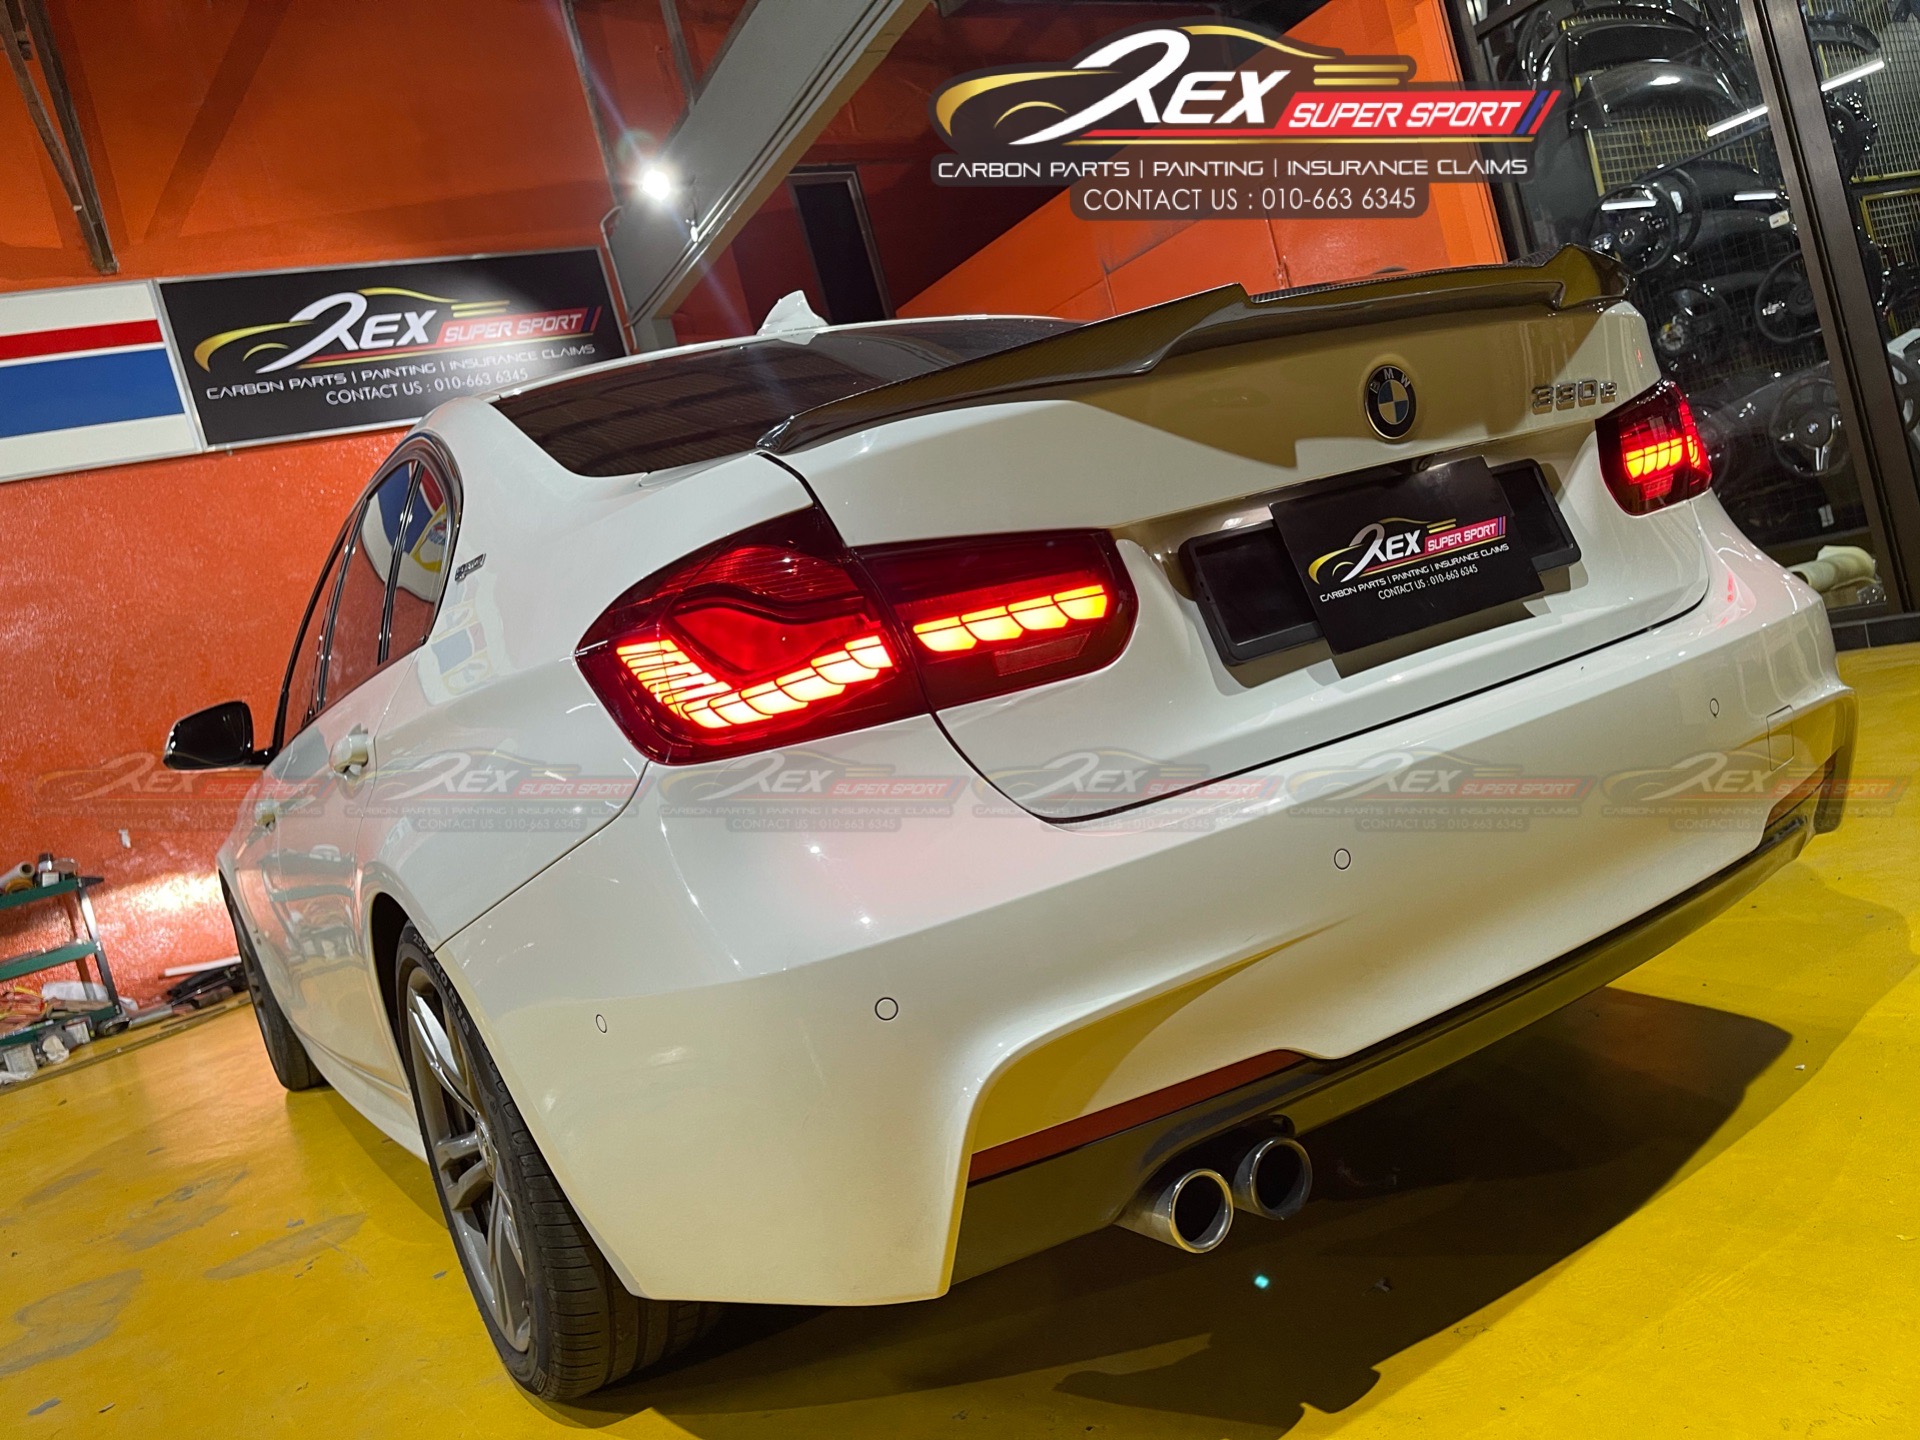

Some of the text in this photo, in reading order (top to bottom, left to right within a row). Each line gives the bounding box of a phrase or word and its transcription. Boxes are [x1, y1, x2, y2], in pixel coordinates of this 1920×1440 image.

[443, 313, 582, 344] SUPER SPORT
[206, 343, 596, 400] CARBON PARTS PAINTING INSURANCE CLAIMS
[325, 368, 529, 406] CONTACT US 010-663 6345
[1369, 368, 1411, 394] BMW
[1427, 523, 1497, 552] SUPER SPORT
[1319, 543, 1510, 603] CARBON PARTS PAINTING INSURANCE CLAIMS
[1377, 564, 1479, 600] CONTACT US 010-663 6345
